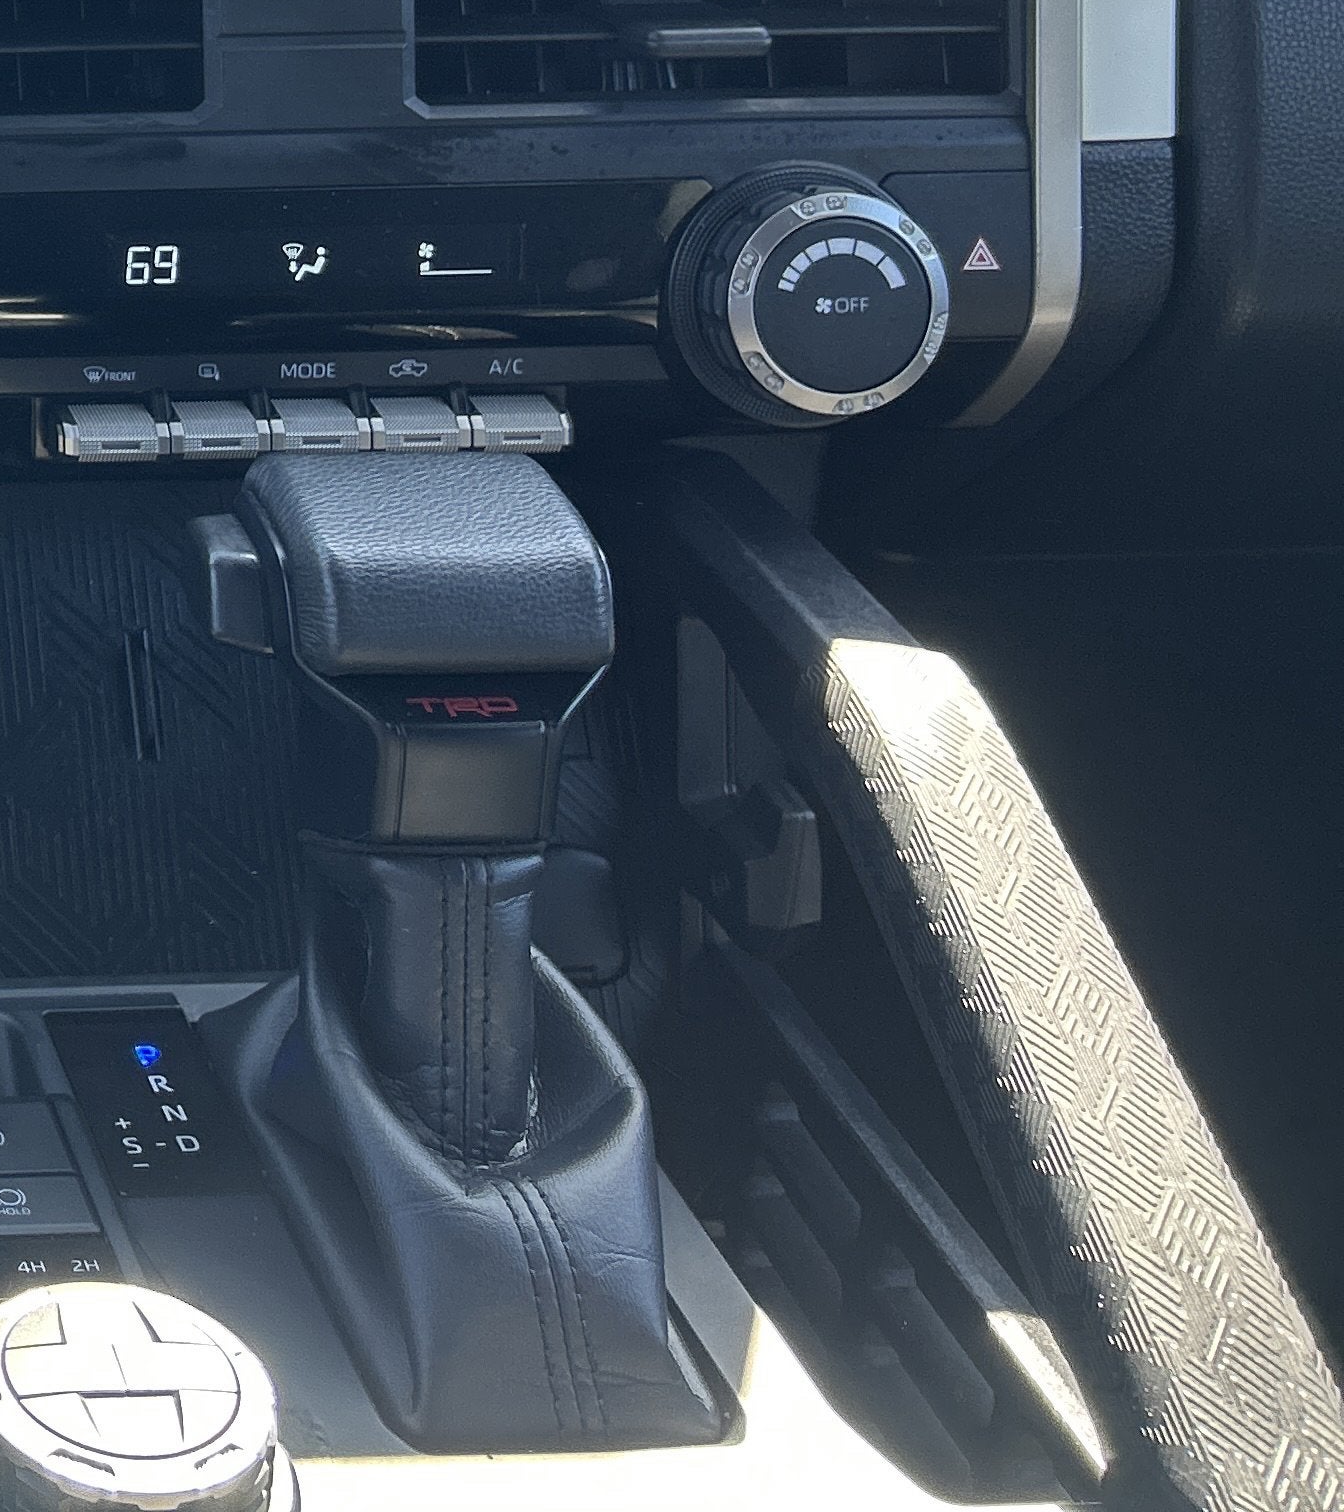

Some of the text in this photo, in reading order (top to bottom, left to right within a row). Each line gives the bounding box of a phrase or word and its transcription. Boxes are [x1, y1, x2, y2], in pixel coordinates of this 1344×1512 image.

[124, 245, 179, 285] 69
[834, 297, 869, 314] OFF
[104, 370, 136, 382] FRONT
[280, 361, 336, 379] MODE
[489, 358, 523, 376] A/C
[406, 696, 518, 718] TRD
[148, 1075, 174, 1093] R
[161, 1105, 188, 1122] N
[122, 1135, 200, 1154] S D
[17, 1260, 46, 1273] 4H
[72, 1259, 100, 1273] 2H
